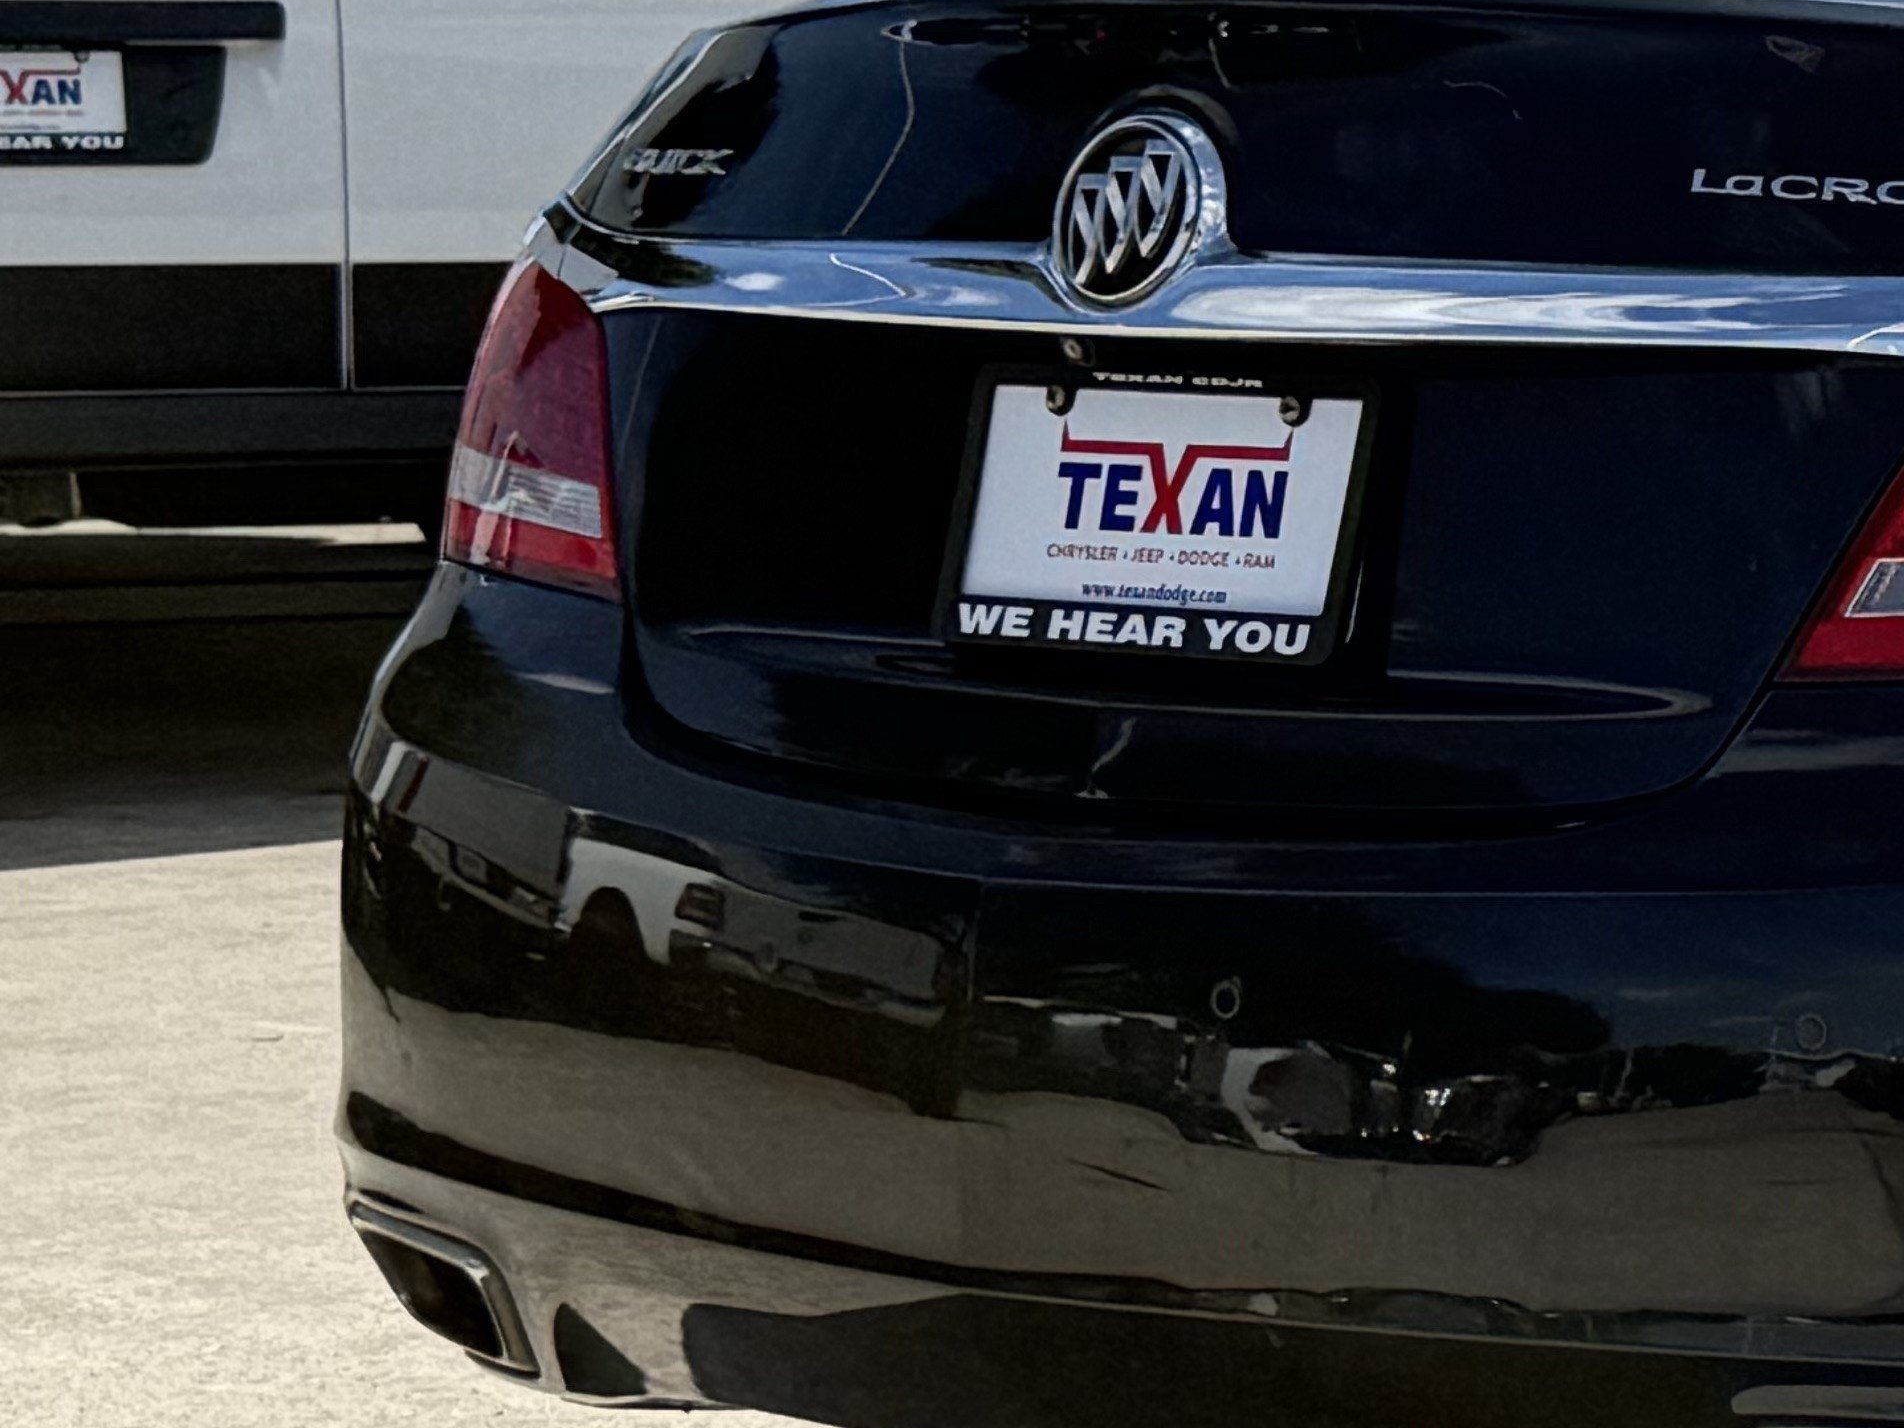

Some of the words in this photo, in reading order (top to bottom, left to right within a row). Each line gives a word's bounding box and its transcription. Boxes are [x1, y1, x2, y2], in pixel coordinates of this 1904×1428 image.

[61, 135, 125, 150] YOU
[1058, 438, 1289, 540] TEXAN
[1046, 542, 1118, 562] CHRYSLER
[1130, 546, 1165, 565] JEEP
[1177, 549, 1230, 568] DODGE
[1242, 553, 1276, 569] RAM
[1081, 581, 1228, 606] www.texandodge.com
[958, 602, 1035, 638] WE
[1046, 608, 1187, 648] HEAR
[1202, 617, 1311, 656] YOU
